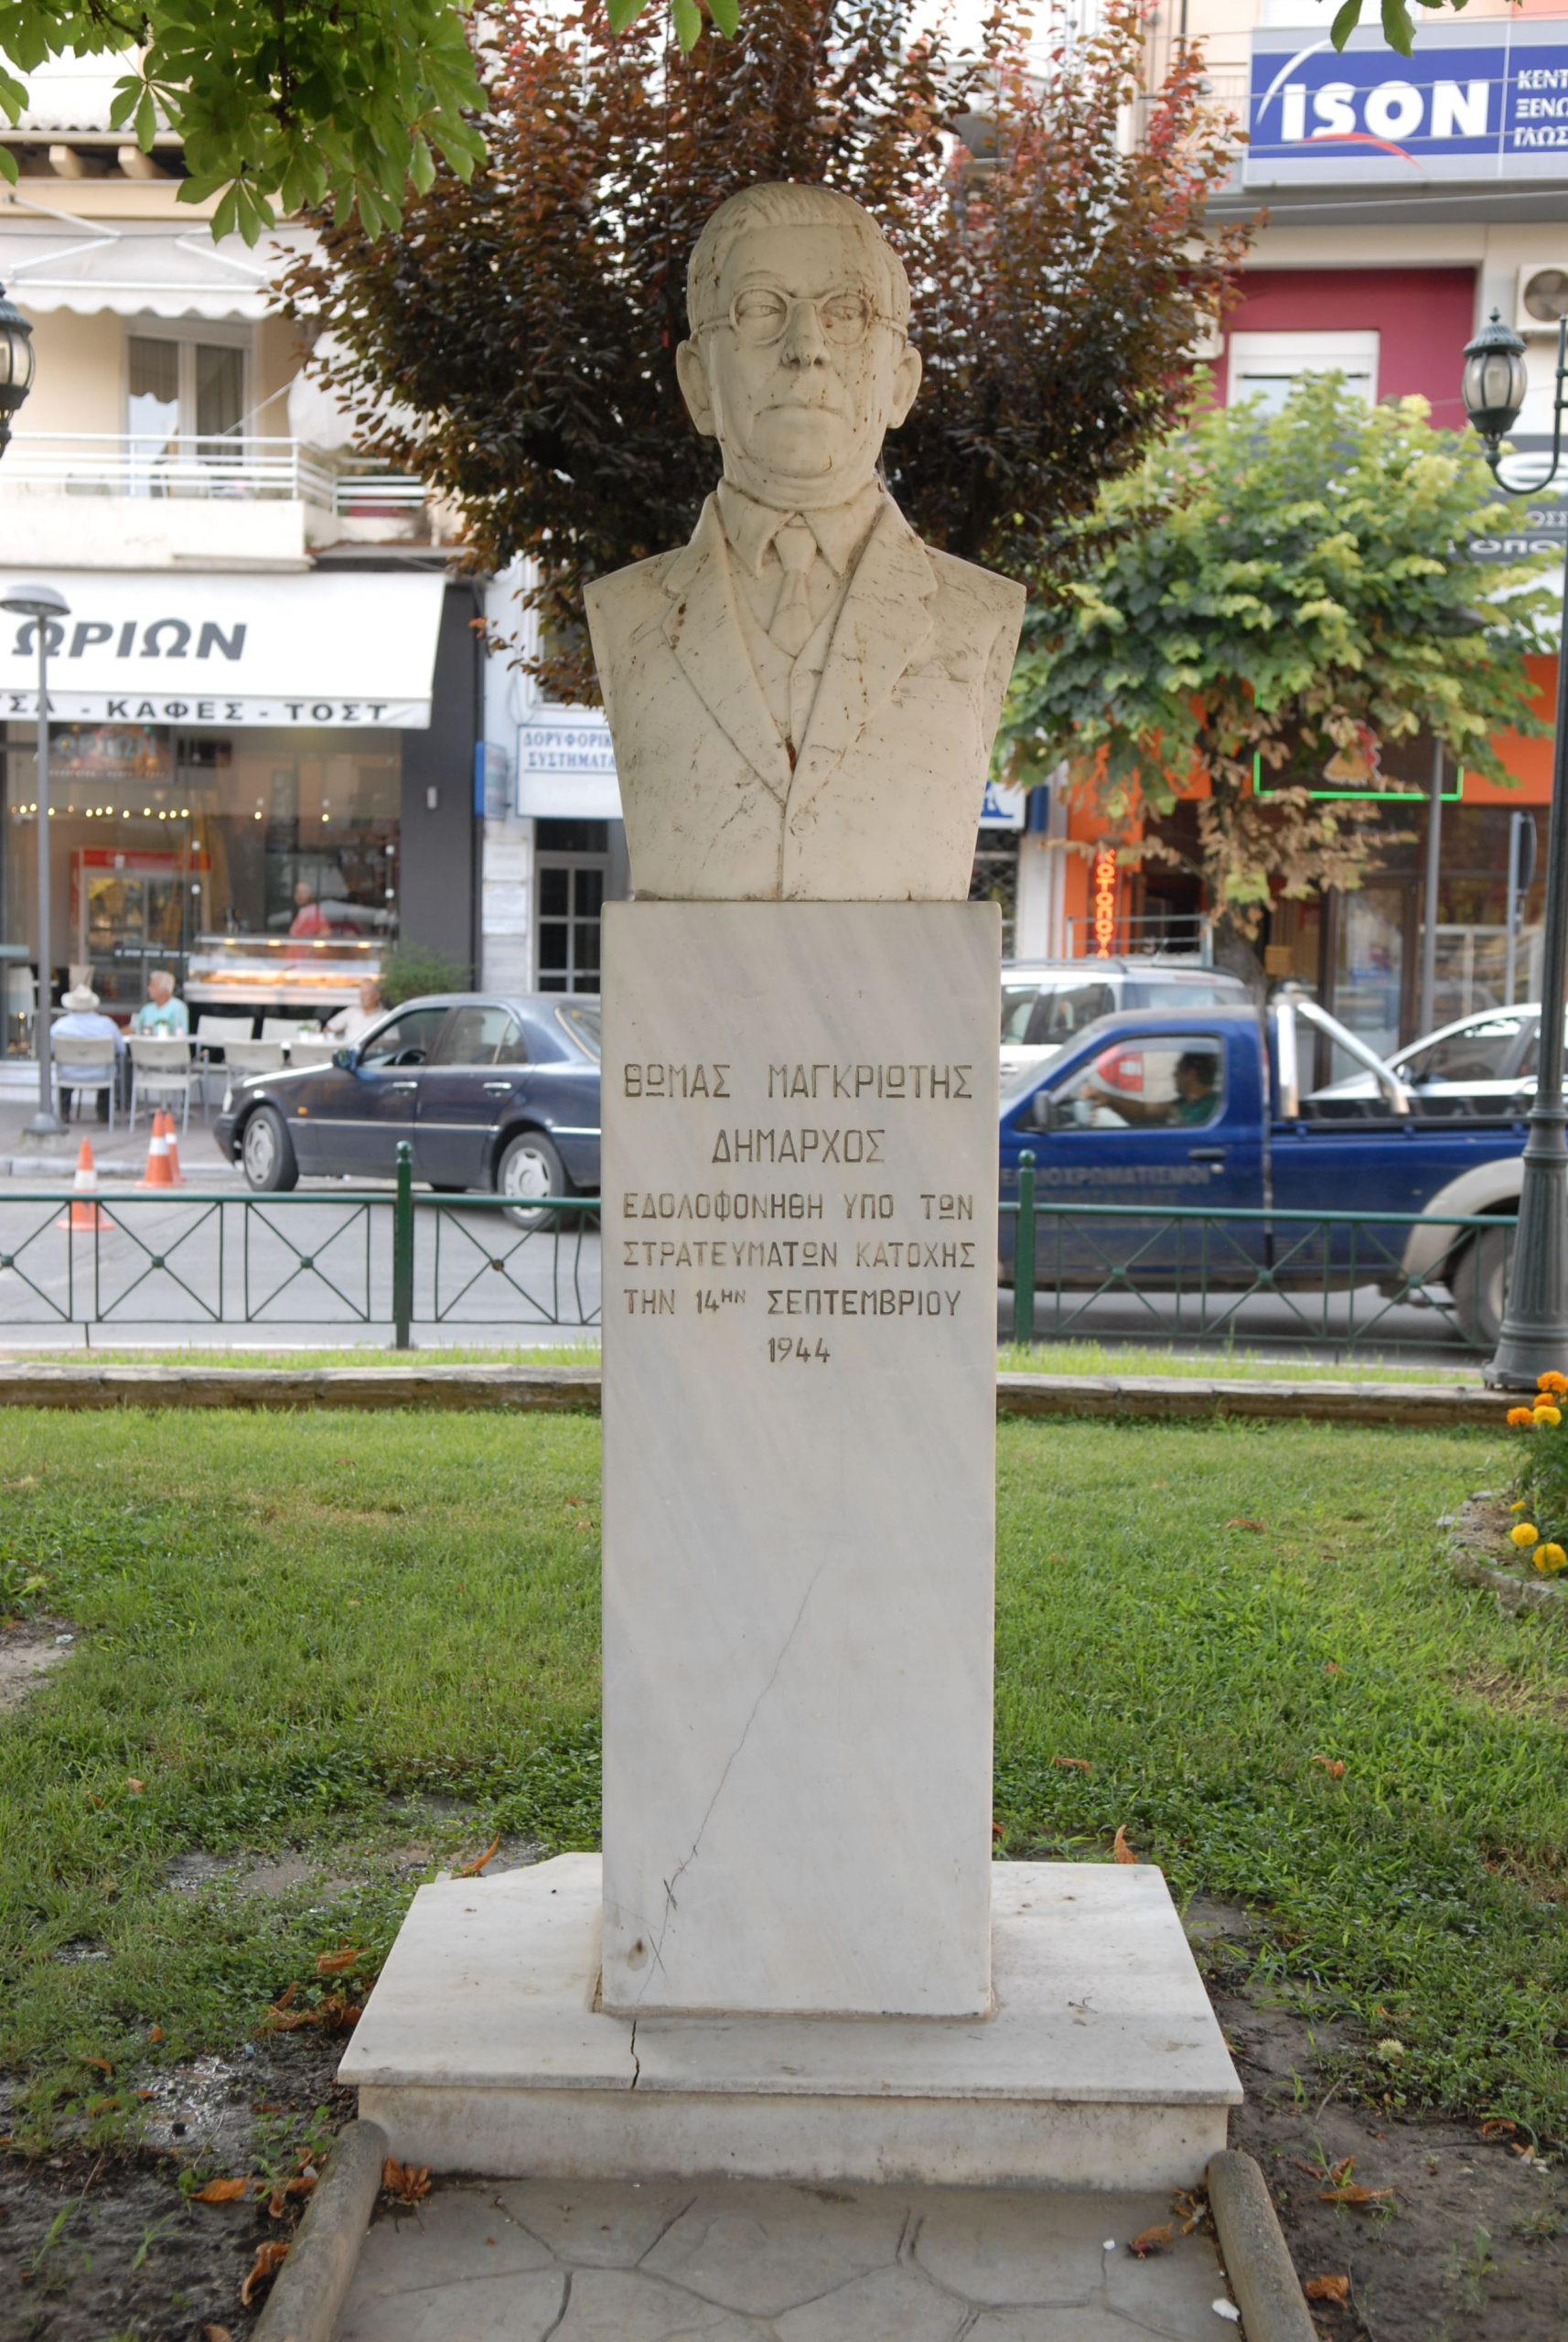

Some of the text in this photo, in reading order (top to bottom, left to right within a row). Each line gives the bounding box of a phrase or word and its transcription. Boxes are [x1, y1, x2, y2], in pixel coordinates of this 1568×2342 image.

[1281, 80, 1489, 141] ISON
[11, 618, 247, 661] ΩΡΙΩΝ
[107, 699, 243, 721] ΚΑΦΕΣ
[285, 703, 388, 721] ΤΟΣΤ
[623, 1063, 972, 1099] ΘΩΜΑΣ ΜΑΓΚΡΙΩΤΗΣ
[712, 1129, 886, 1164] ΔΗΜΑΡΧΟΣ
[623, 1190, 973, 1221] ΕΔΟΛΟΦΟΝΗΘΗ ΥΠΟ ΤΩΝ
[623, 1241, 976, 1268] ΣΤΡΑΤΕΥΜΑΤΩΝ ΚΑΤΟΧΗΣ
[623, 1288, 675, 1315] ΤΗΝ
[767, 1289, 961, 1316] ΣΕΠΤΕΜΒΡΙΟΥ
[768, 1337, 831, 1363] 1944
